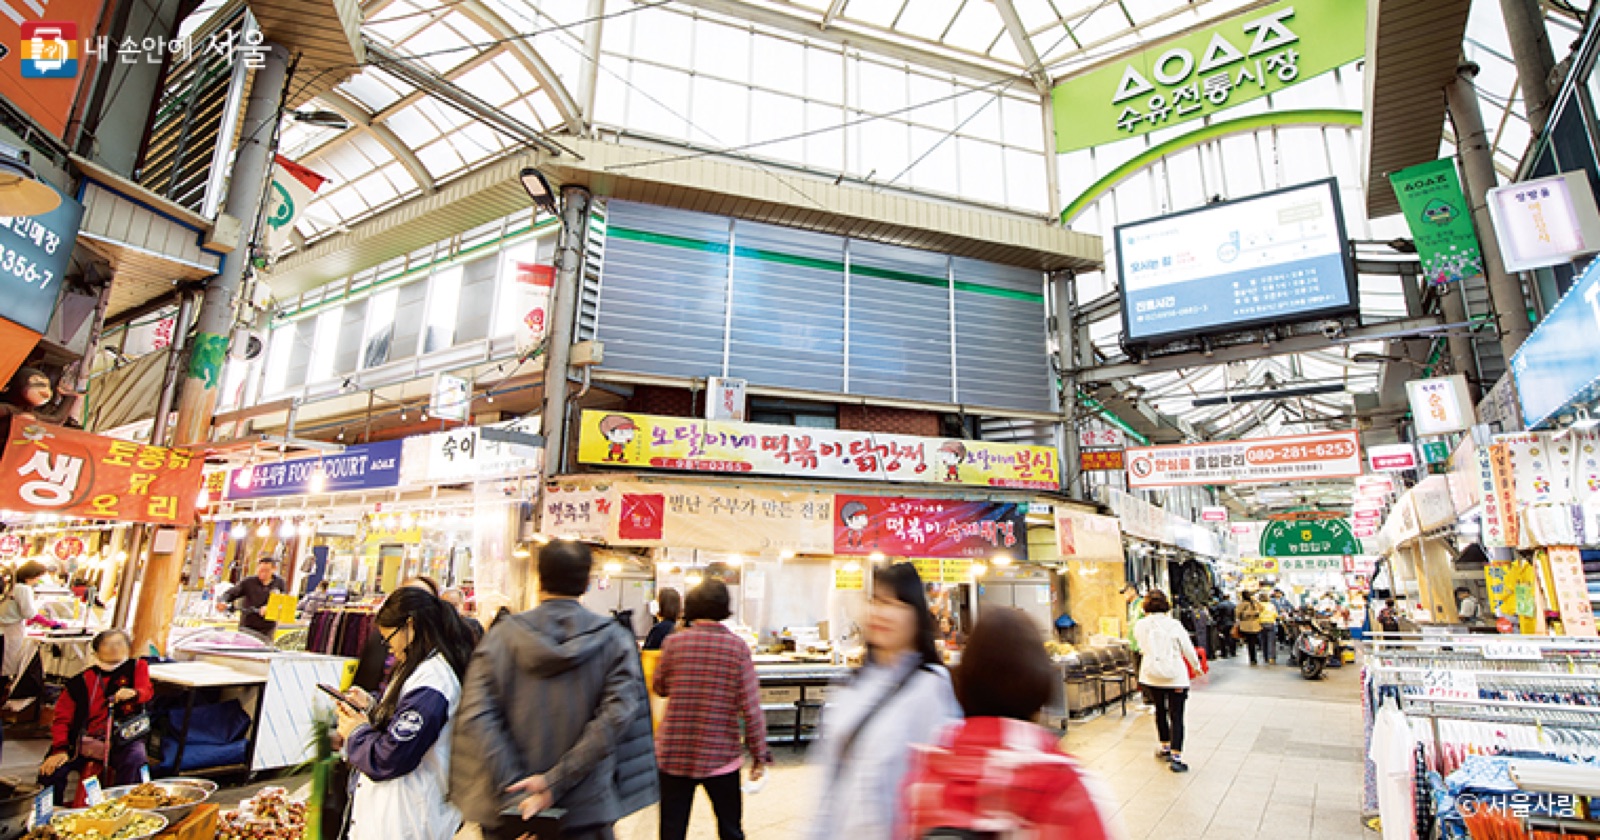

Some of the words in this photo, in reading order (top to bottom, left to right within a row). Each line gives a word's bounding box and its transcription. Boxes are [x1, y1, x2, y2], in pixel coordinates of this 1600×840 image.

[1117, 48, 1300, 133] 수유전통시장
[0, 243, 54, 290] 356-7
[102, 439, 195, 470] 토종닭
[1013, 449, 1055, 480] 분식
[1247, 439, 1355, 463] 080-281-6253
[17, 450, 85, 506] 생
[324, 455, 369, 479] COURT
[669, 494, 702, 514] 별난
[707, 496, 757, 517] 주부가
[762, 500, 795, 519] 만든
